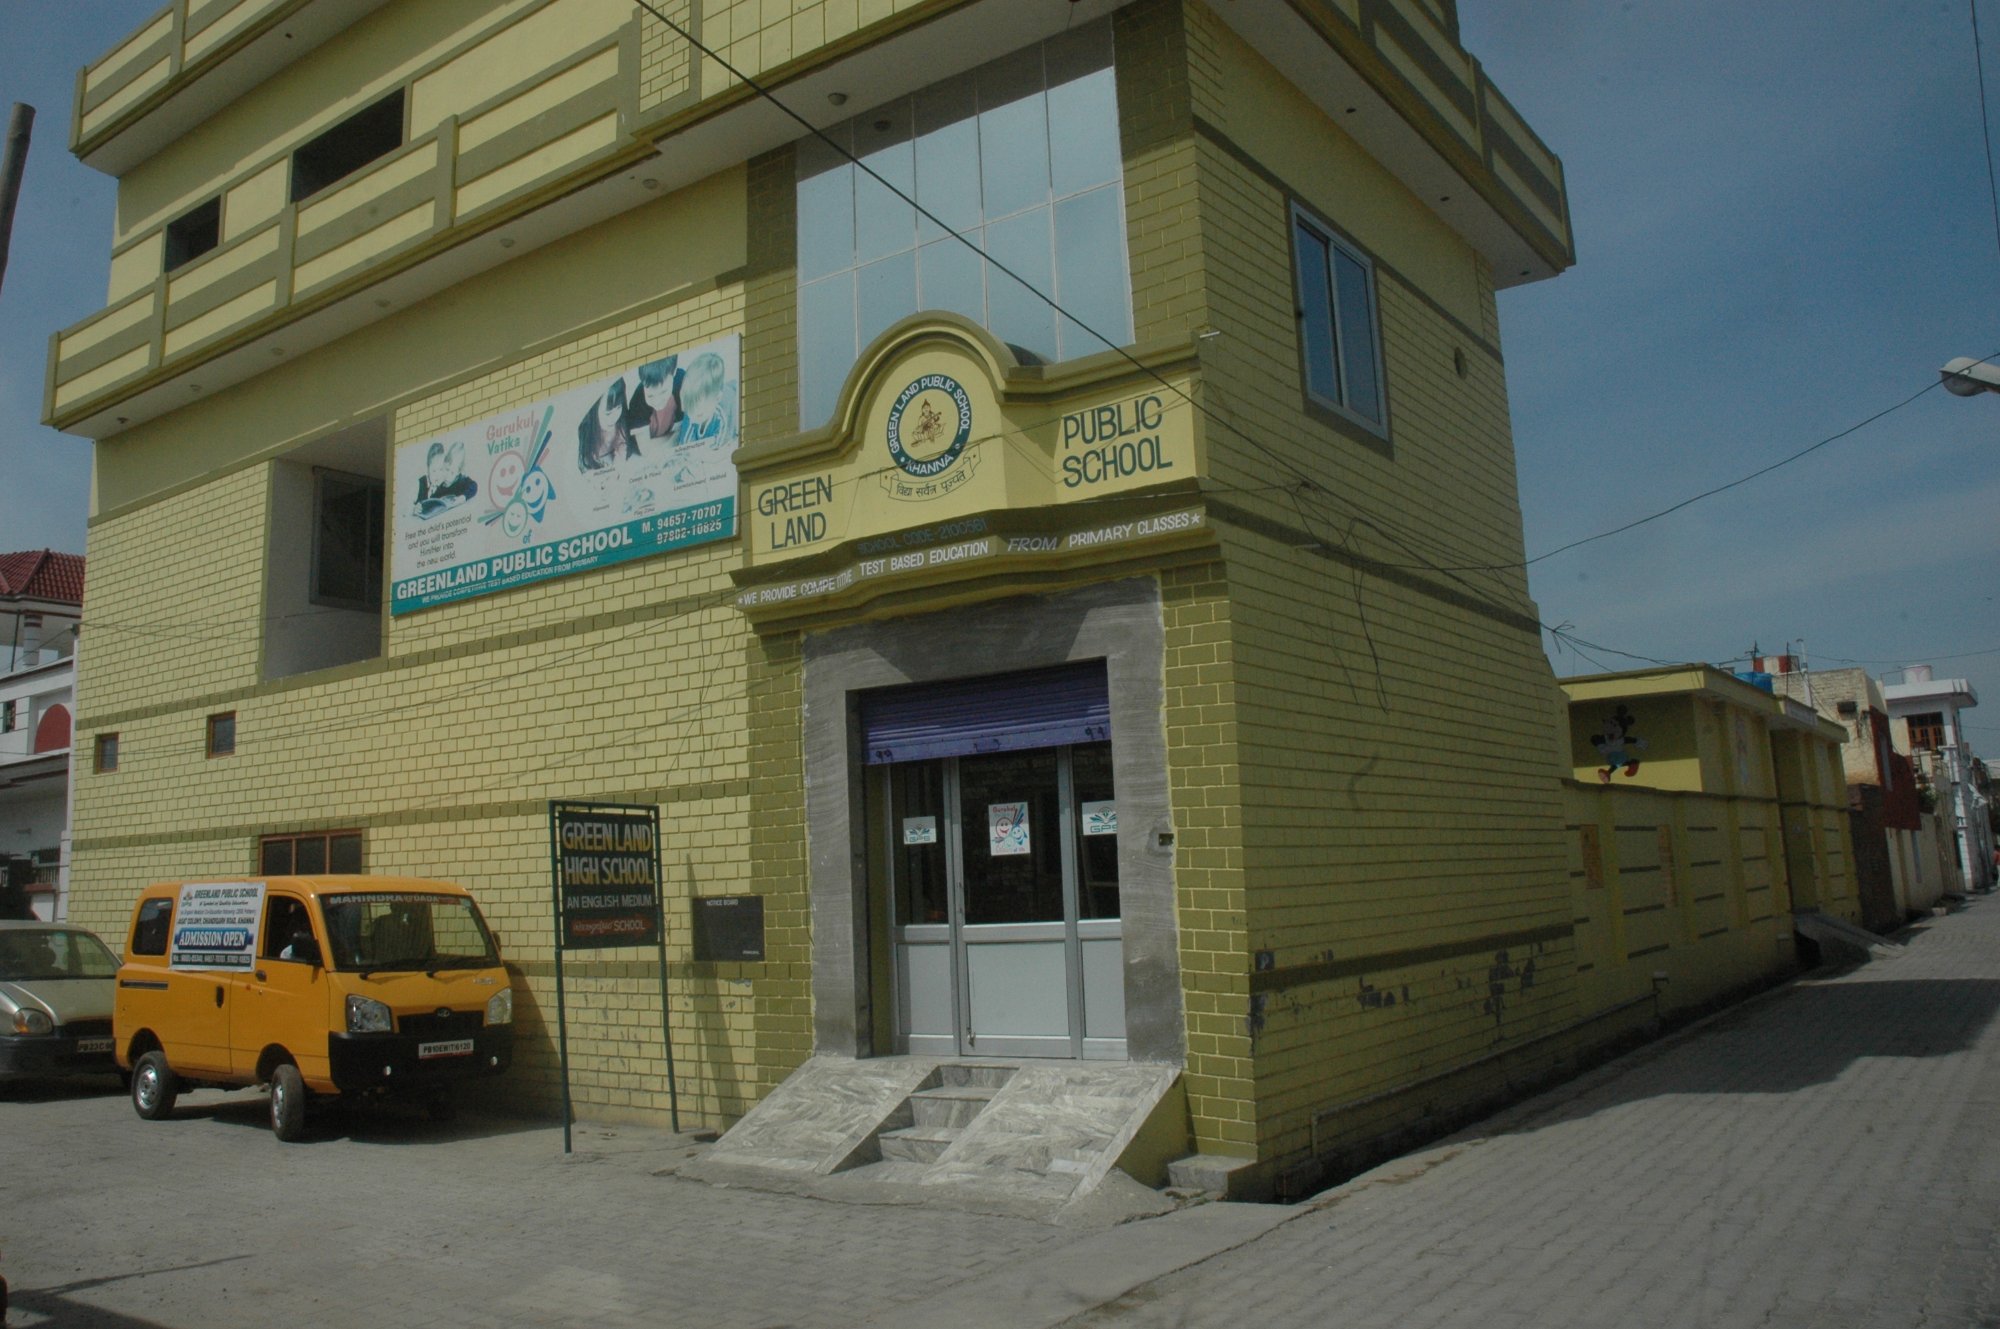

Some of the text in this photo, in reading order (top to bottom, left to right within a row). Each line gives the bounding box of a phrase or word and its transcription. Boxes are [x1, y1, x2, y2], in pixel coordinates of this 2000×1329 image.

[486, 410, 535, 441] Gurukul
[888, 375, 970, 454] GREEN LAND PUBLIC SCHOOL
[1063, 395, 1163, 449] PUBLIC
[487, 435, 521, 456] Vatika
[906, 454, 954, 475] KHANNA
[1062, 435, 1173, 488] SCHOOL
[758, 474, 832, 517] GREEN
[417, 529, 426, 537] the
[445, 514, 472, 529] potential
[642, 503, 722, 533] M. 94657-70707
[771, 511, 827, 550] LAND
[408, 527, 468, 550] and you will transform
[522, 529, 532, 544] of
[397, 526, 633, 600] GREENLAND PUBLIC SCHOOL
[416, 560, 426, 569] the
[426, 557, 438, 565] new
[488, 579, 501, 588] TEST
[521, 566, 554, 580] EDUCATION
[554, 562, 571, 573] FROM
[572, 556, 599, 568] PRIMARY
[743, 512, 1189, 606] WE PROVIDE COMPETITIVE TEST BASED EDUCATION FROM PRIMARY CLASSES
[562, 821, 652, 852] GREEN LAND
[564, 856, 654, 885] HIGH SCHOOL
[330, 894, 404, 904] MAHINDRA
[567, 894, 652, 909] AN ENGLISH MEDIUM
[178, 931, 247, 946] ADMISSION OPEN
[613, 919, 647, 932] SCHOOL
